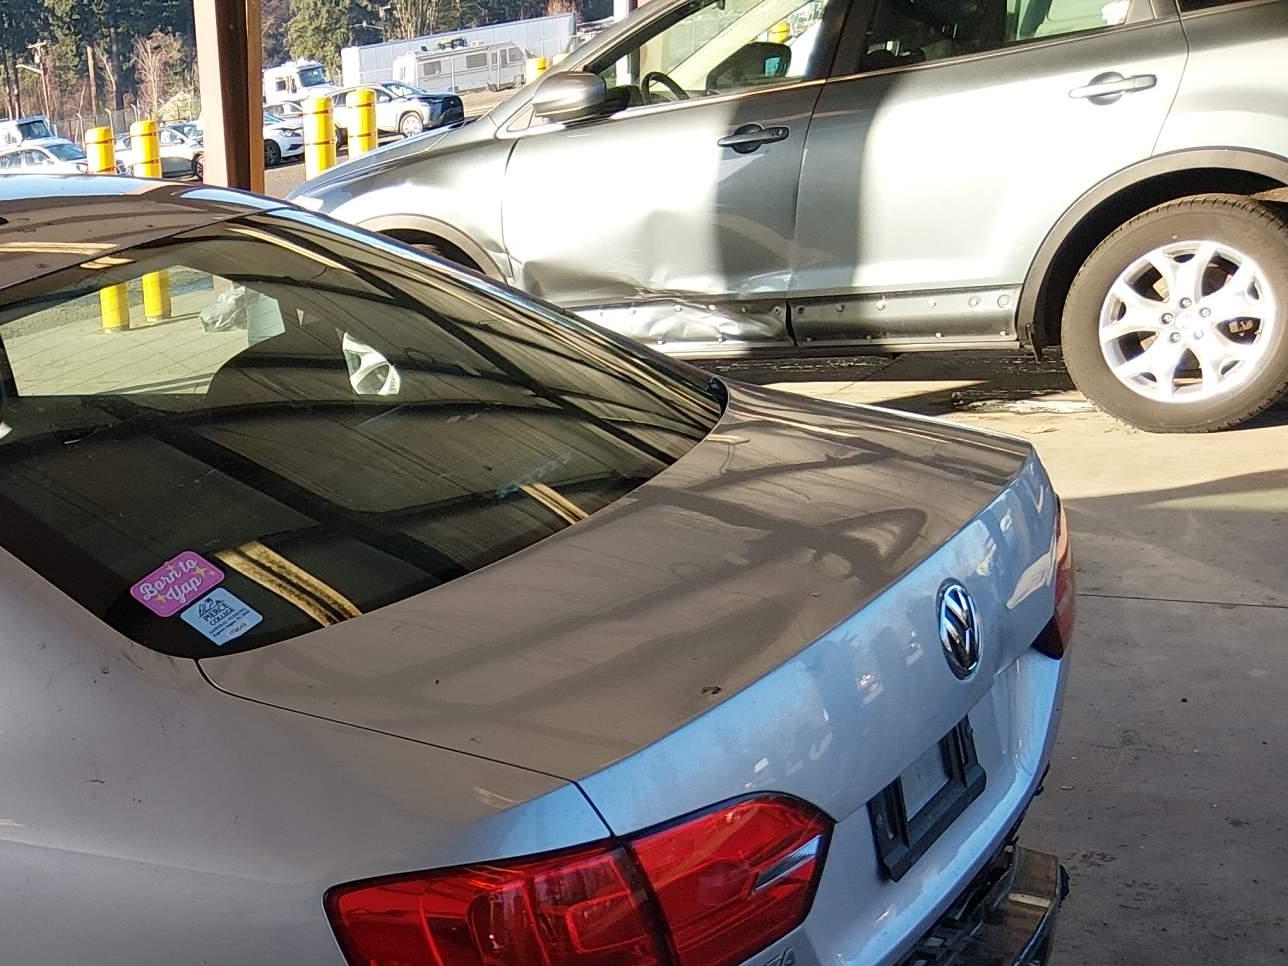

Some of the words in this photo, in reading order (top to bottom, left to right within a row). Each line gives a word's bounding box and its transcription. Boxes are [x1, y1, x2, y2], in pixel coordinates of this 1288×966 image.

[140, 570, 182, 600] Born
[178, 559, 198, 573] to
[166, 576, 202, 603] Yap
[203, 601, 230, 622] PIERCE
